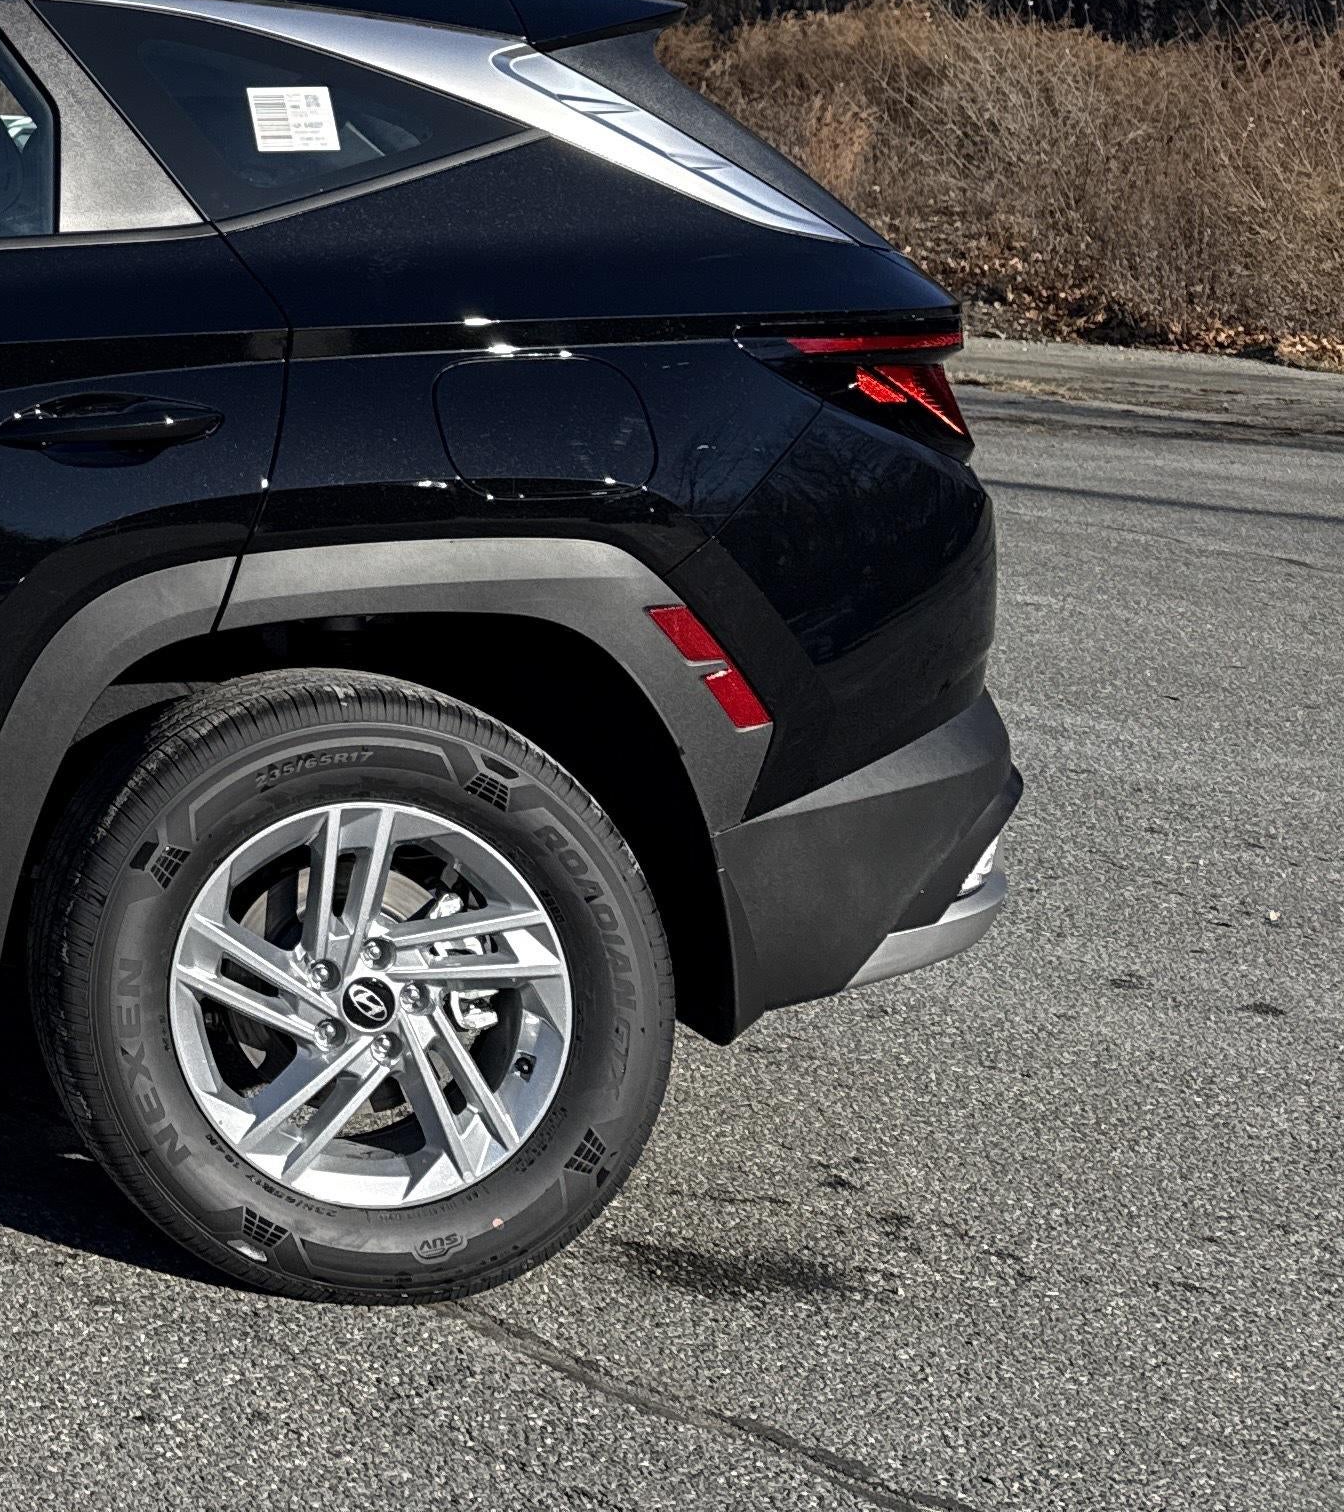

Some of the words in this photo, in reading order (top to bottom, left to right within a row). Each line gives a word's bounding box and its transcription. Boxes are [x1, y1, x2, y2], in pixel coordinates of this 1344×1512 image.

[255, 751, 374, 790] 235/65R17
[533, 824, 637, 1011] ROADIAN
[116, 958, 192, 1167] NEXEN
[419, 1232, 461, 1252] SUV
